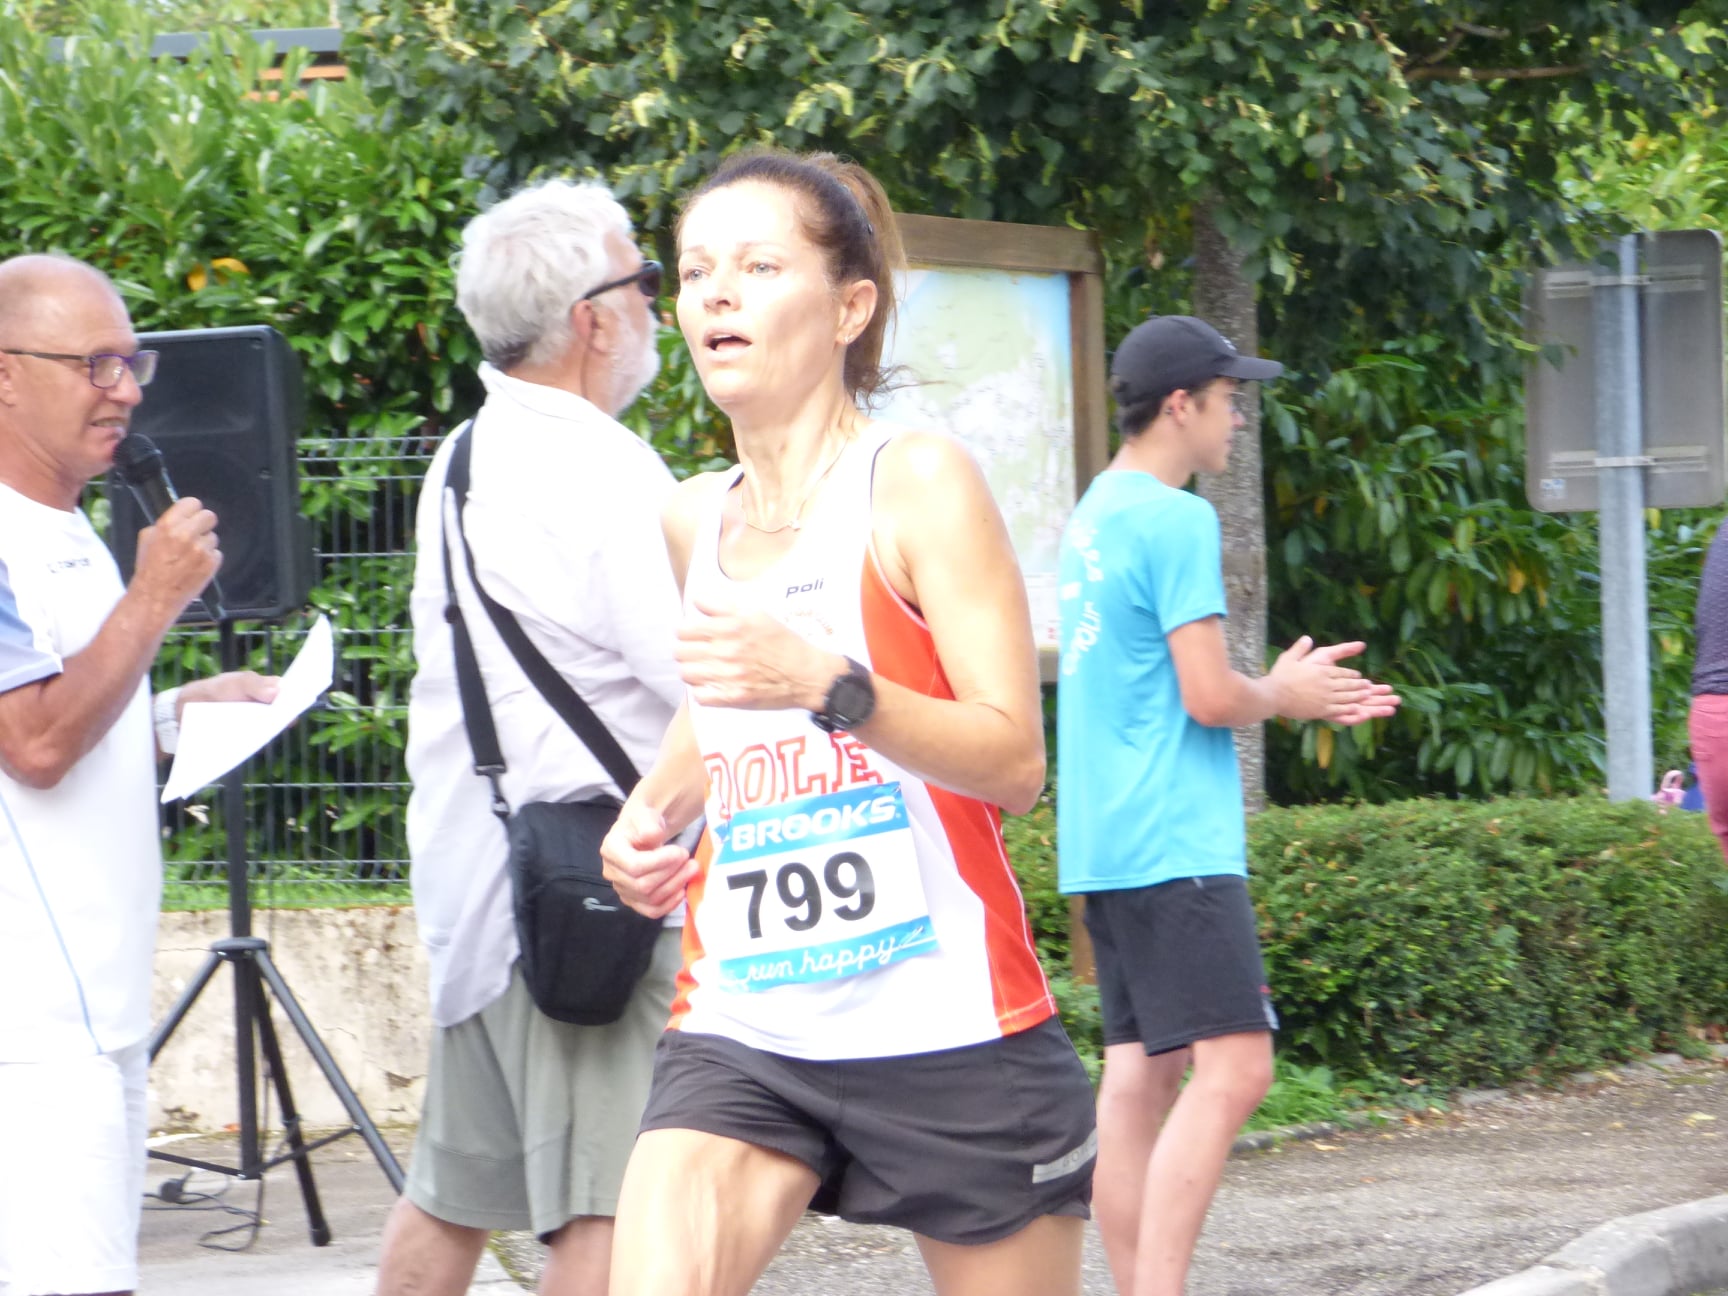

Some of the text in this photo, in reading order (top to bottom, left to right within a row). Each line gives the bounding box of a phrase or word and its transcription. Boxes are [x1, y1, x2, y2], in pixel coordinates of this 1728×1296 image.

[786, 578, 824, 598] poli
[731, 795, 897, 851] BROOKS
[727, 851, 876, 939] 799
[744, 936, 899, 985] run happy
